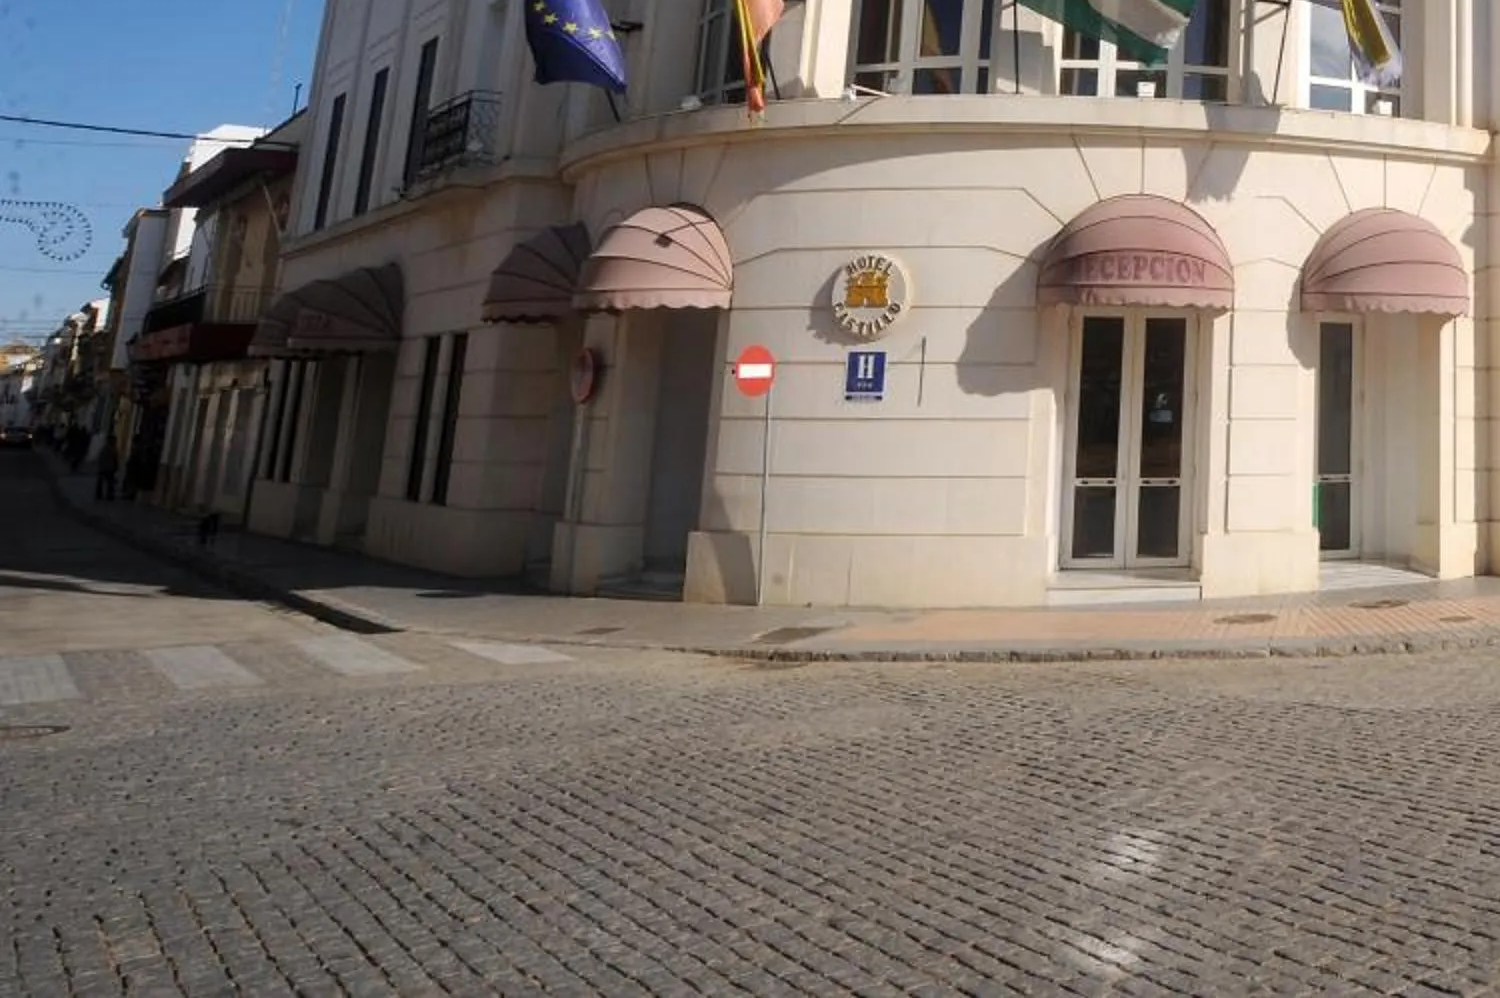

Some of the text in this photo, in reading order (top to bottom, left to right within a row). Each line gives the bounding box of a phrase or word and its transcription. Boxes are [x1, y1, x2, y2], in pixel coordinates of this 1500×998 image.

[845, 255, 894, 277] HOTEL
[833, 302, 901, 335] CASTILLO
[857, 355, 875, 379] H
